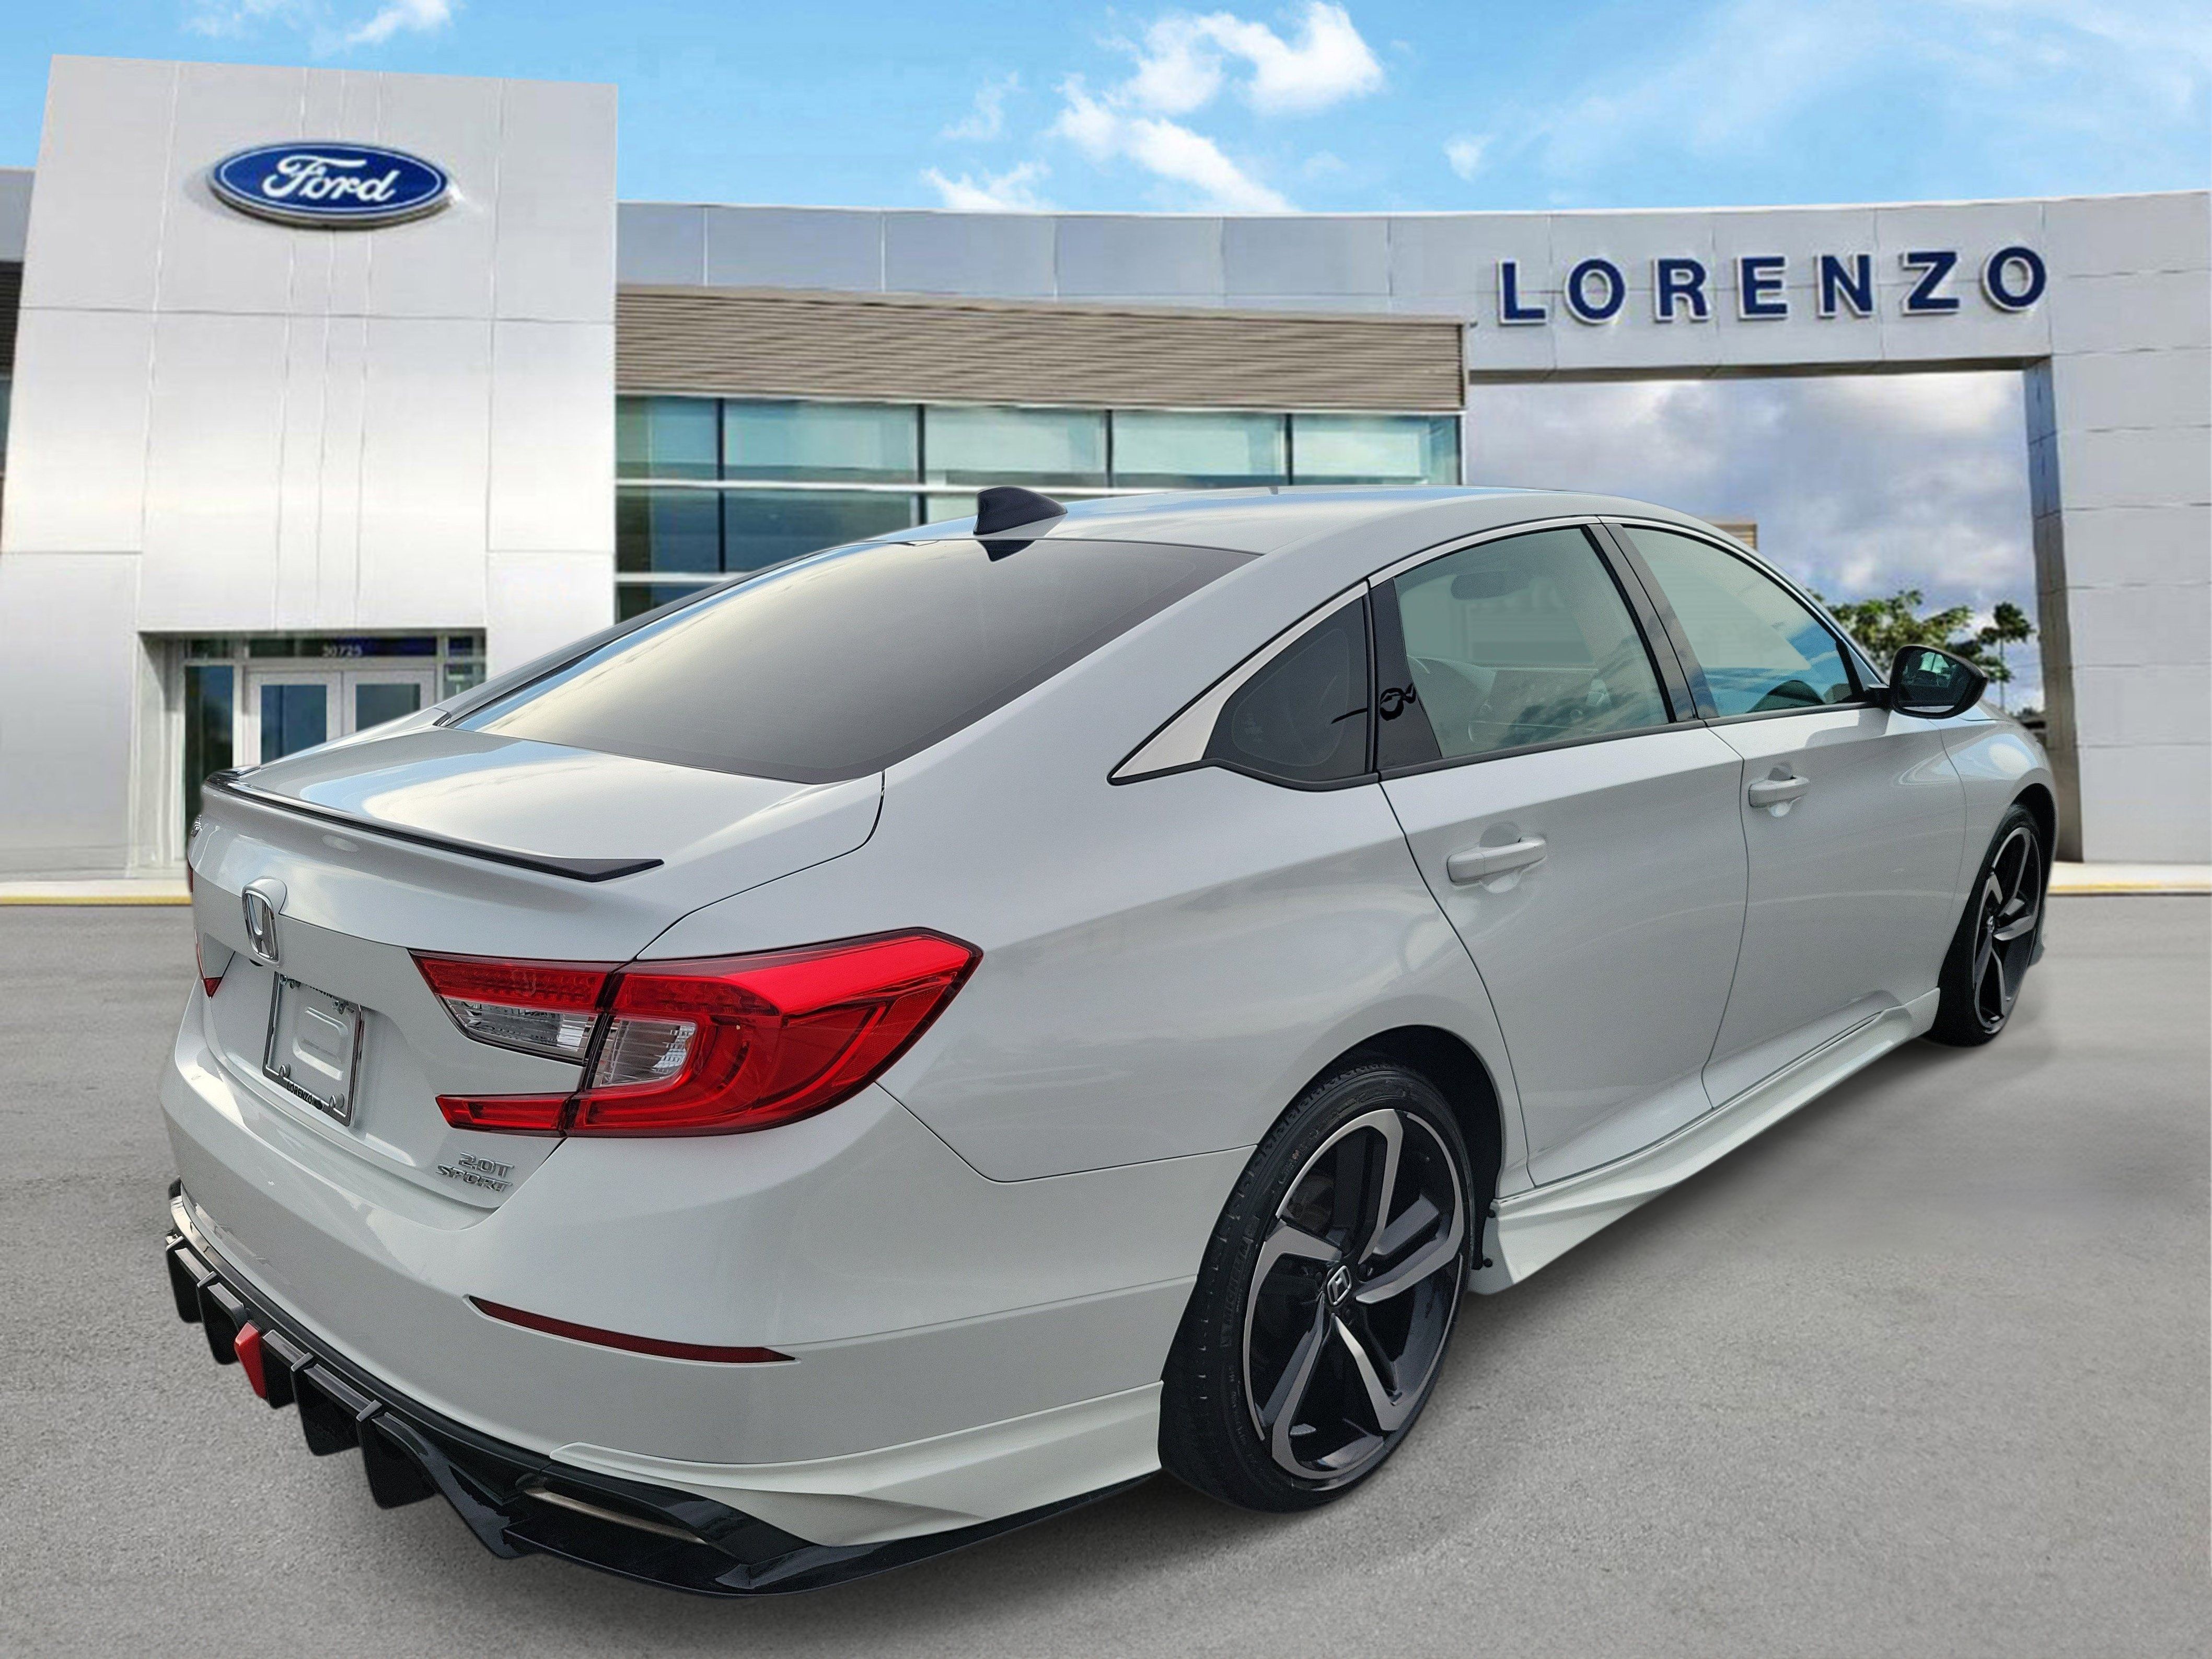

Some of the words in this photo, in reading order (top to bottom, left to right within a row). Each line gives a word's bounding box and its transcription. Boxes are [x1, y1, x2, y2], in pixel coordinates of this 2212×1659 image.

[263, 155, 401, 202] Ford
[1497, 246, 2047, 324] LORENZO
[286, 1081, 312, 1105] LORENZO
[436, 1164, 513, 1192] SPORT
[458, 1152, 514, 1177] 2.0T
